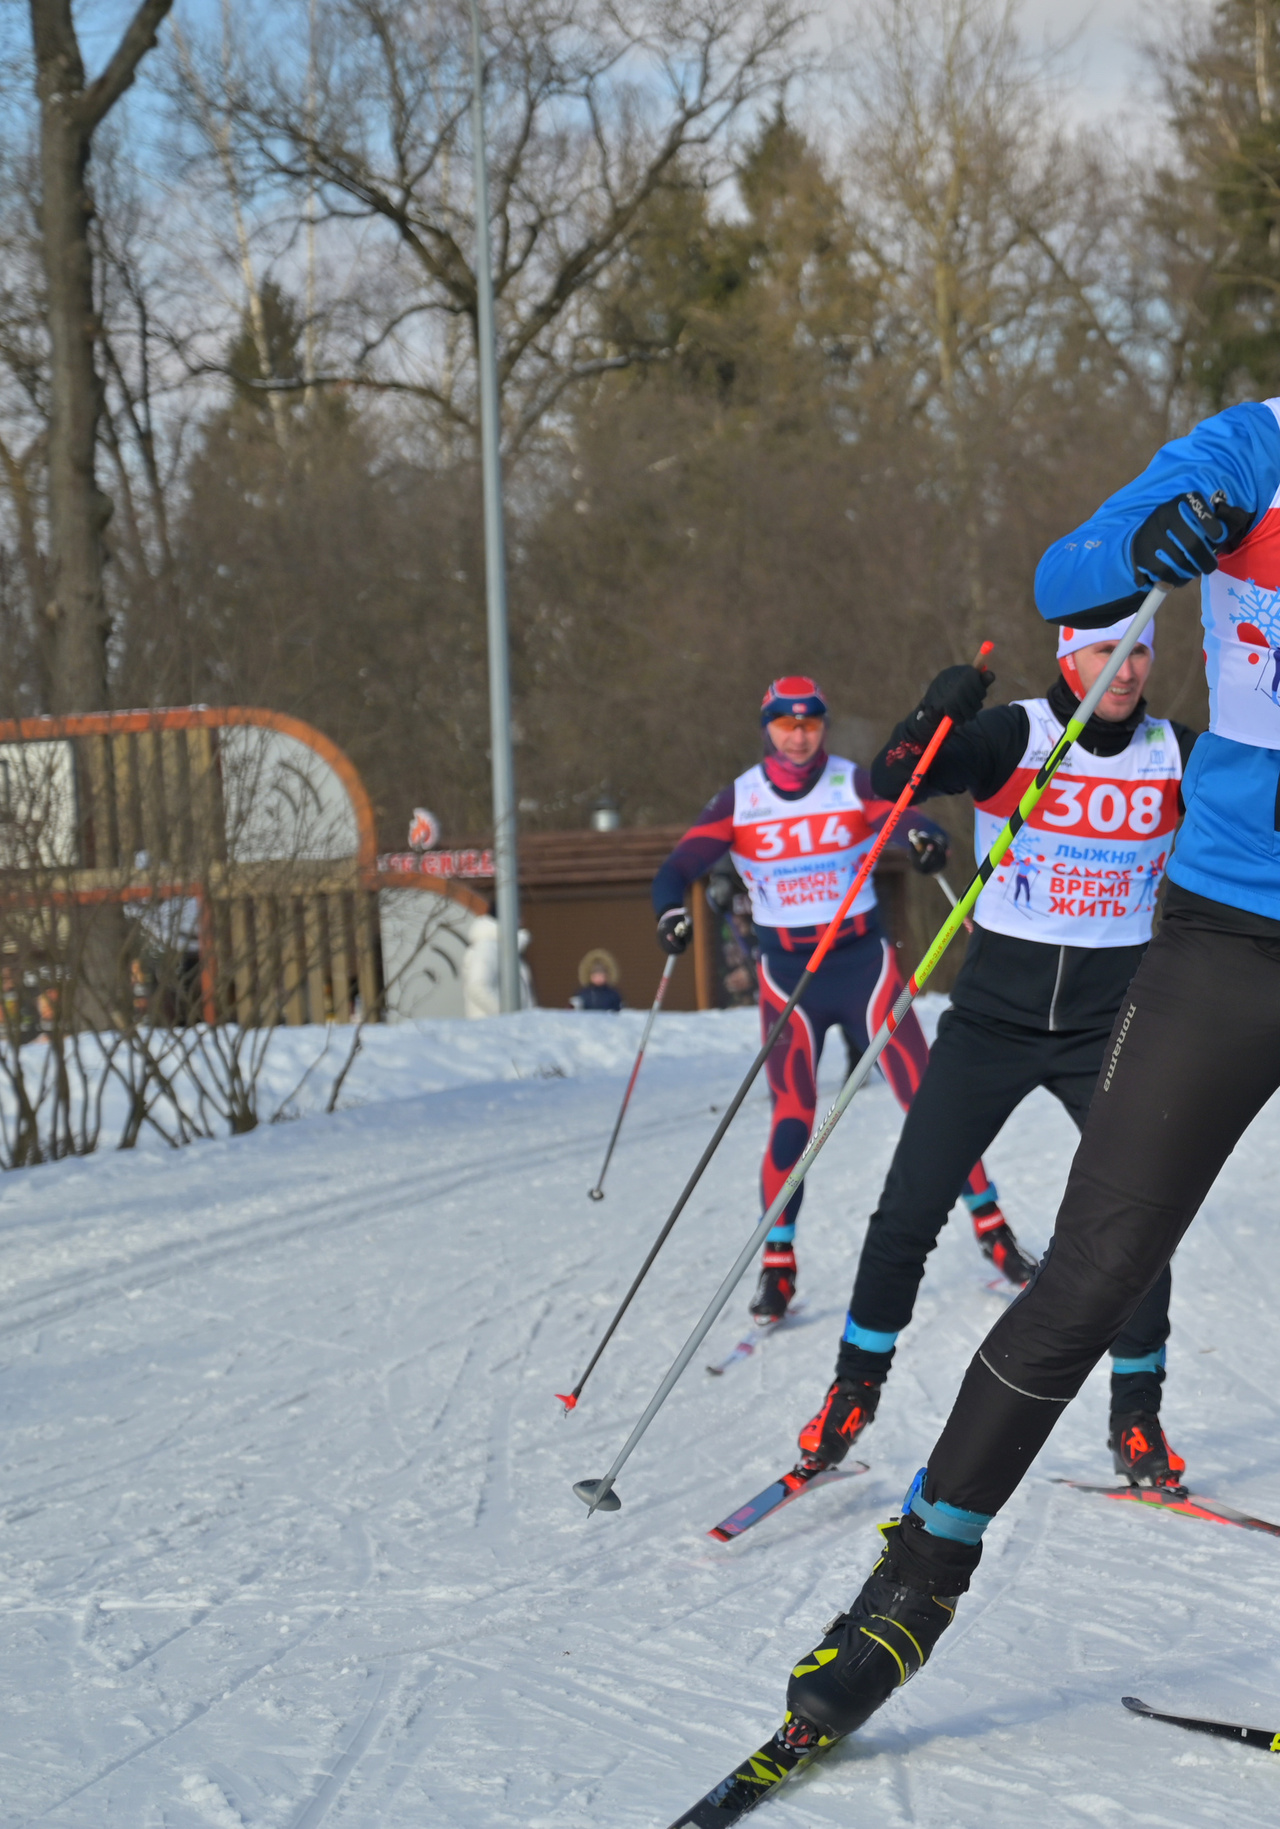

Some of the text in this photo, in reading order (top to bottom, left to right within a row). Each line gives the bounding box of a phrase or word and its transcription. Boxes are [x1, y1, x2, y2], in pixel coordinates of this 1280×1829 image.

[1042, 778, 1164, 834] 308
[755, 815, 852, 859] 314
[1055, 844, 1137, 864] ЛЫЖНЯ
[780, 889, 840, 906] ЖИТЬ
[1049, 877, 1130, 898] ВРЕМЯ
[1048, 896, 1127, 918] ЖИТЬ
[1103, 1002, 1137, 1092] noname
